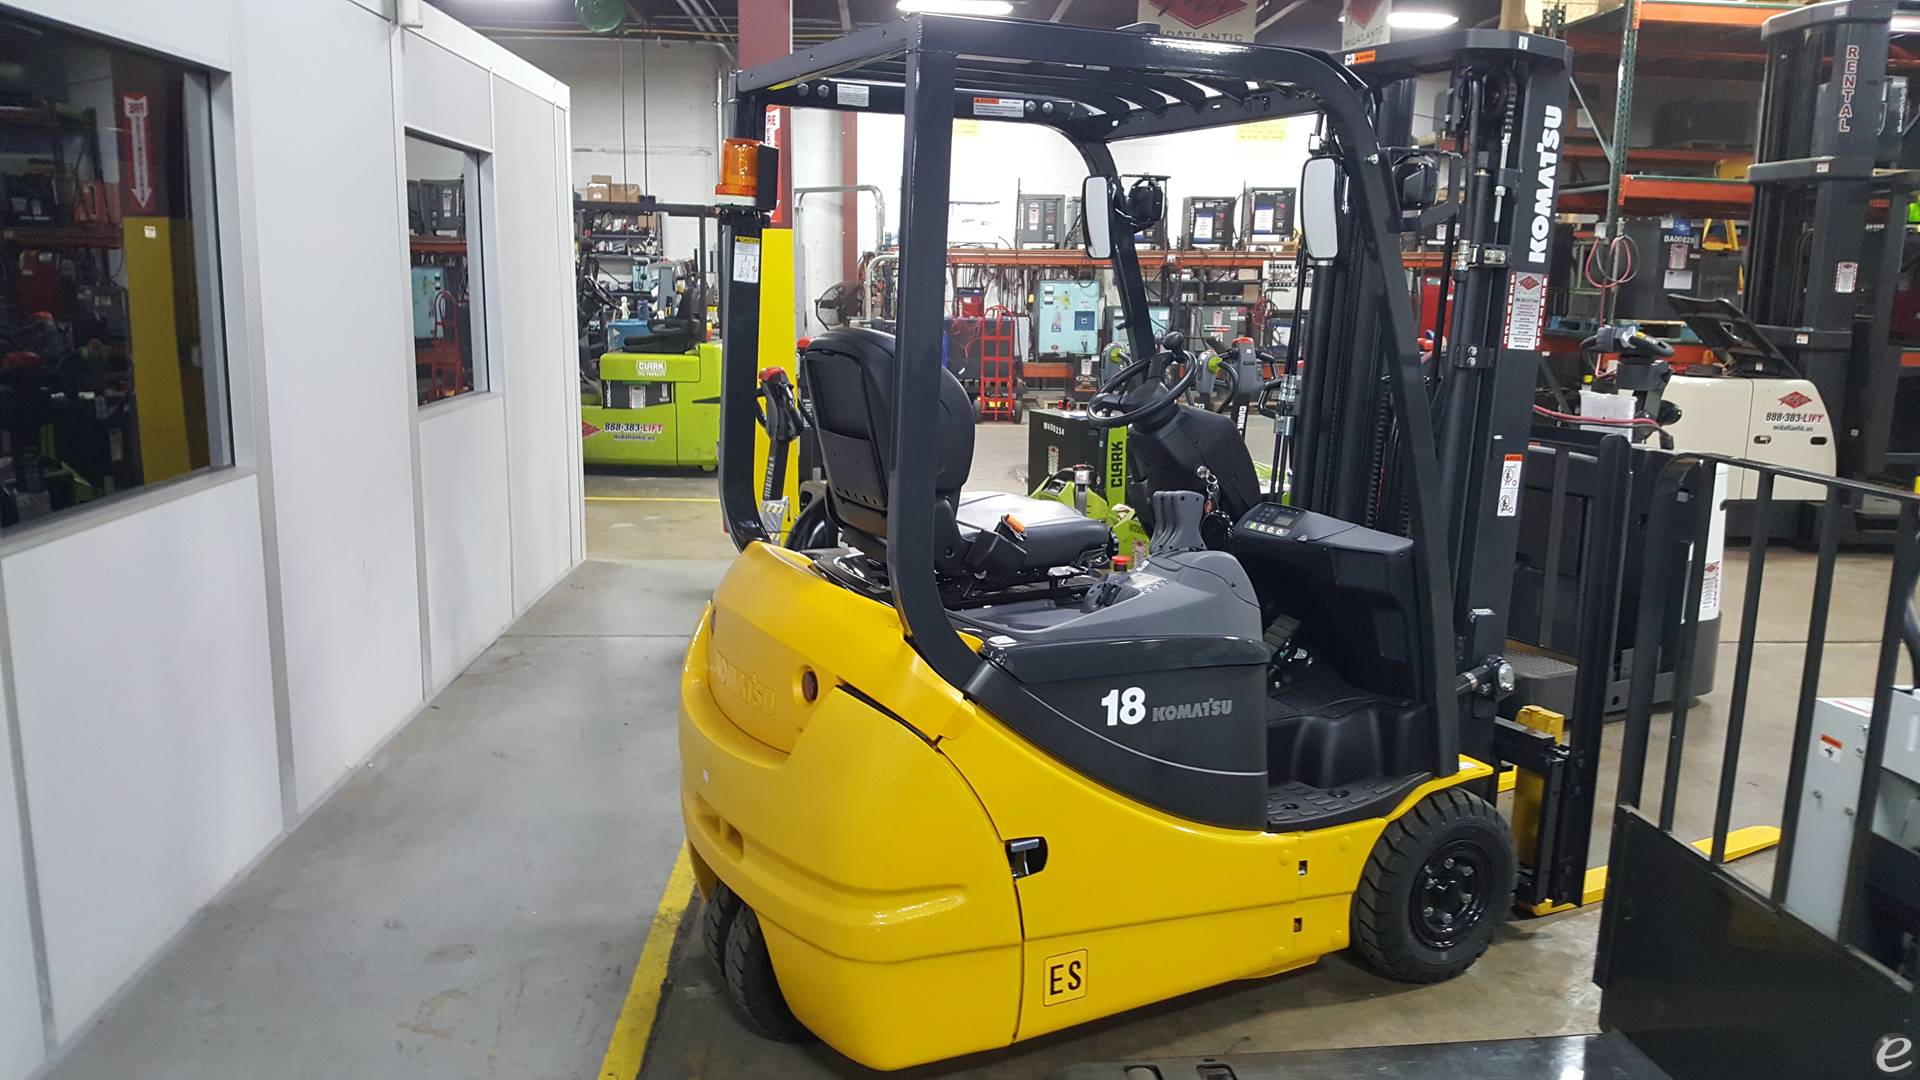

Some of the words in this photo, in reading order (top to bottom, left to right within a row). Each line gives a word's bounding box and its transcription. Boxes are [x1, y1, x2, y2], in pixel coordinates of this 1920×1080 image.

[1839, 44, 1859, 132] RENTAL
[1528, 105, 1563, 264] KOMATSU
[1503, 274, 1516, 345] SERVICE
[1535, 277, 1548, 347] RENTALS
[638, 361, 664, 370] CLARK
[1236, 405, 1248, 430] CLARK
[1110, 441, 1124, 489] CLARK
[1101, 686, 1147, 726] 18
[1152, 698, 1233, 722] KOMATSU
[1050, 960, 1082, 996] ES
